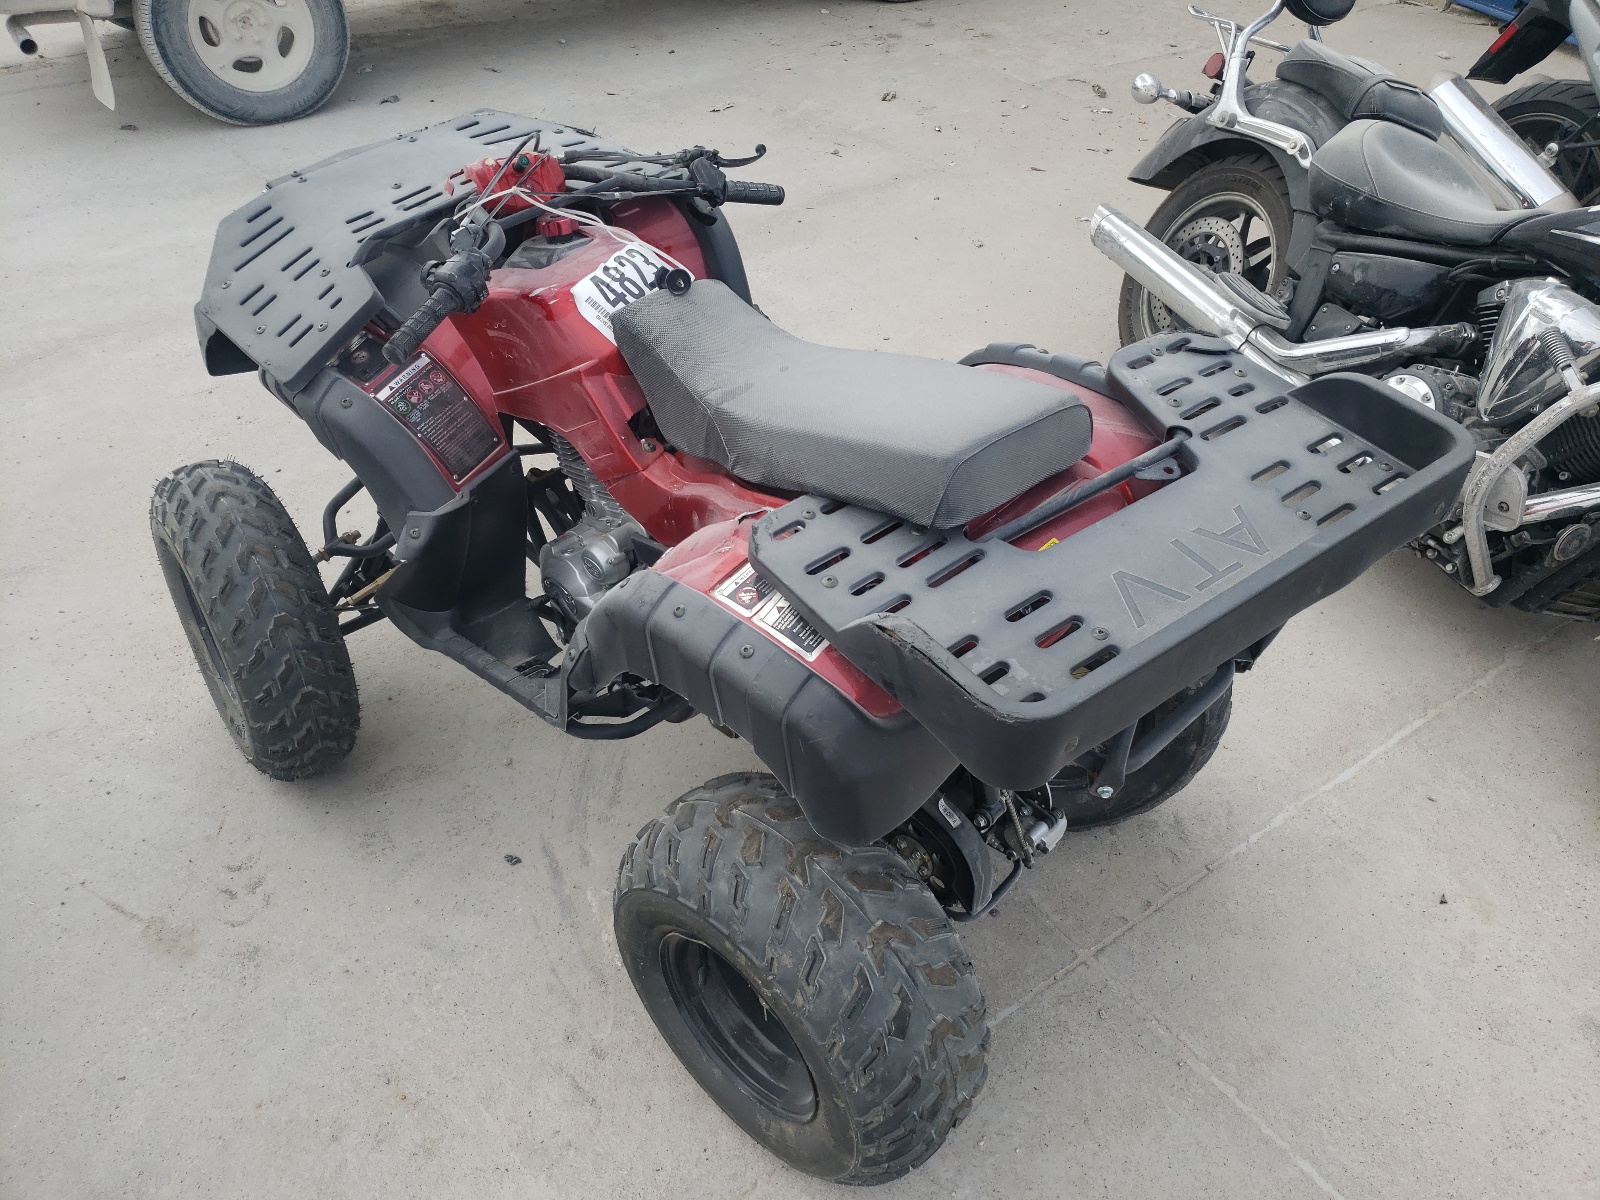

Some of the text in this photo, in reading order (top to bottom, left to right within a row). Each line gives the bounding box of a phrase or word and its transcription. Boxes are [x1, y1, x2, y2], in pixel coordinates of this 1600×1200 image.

[590, 249, 659, 308] 4823
[394, 364, 420, 386] WARNING
[1112, 505, 1269, 628] ATV
